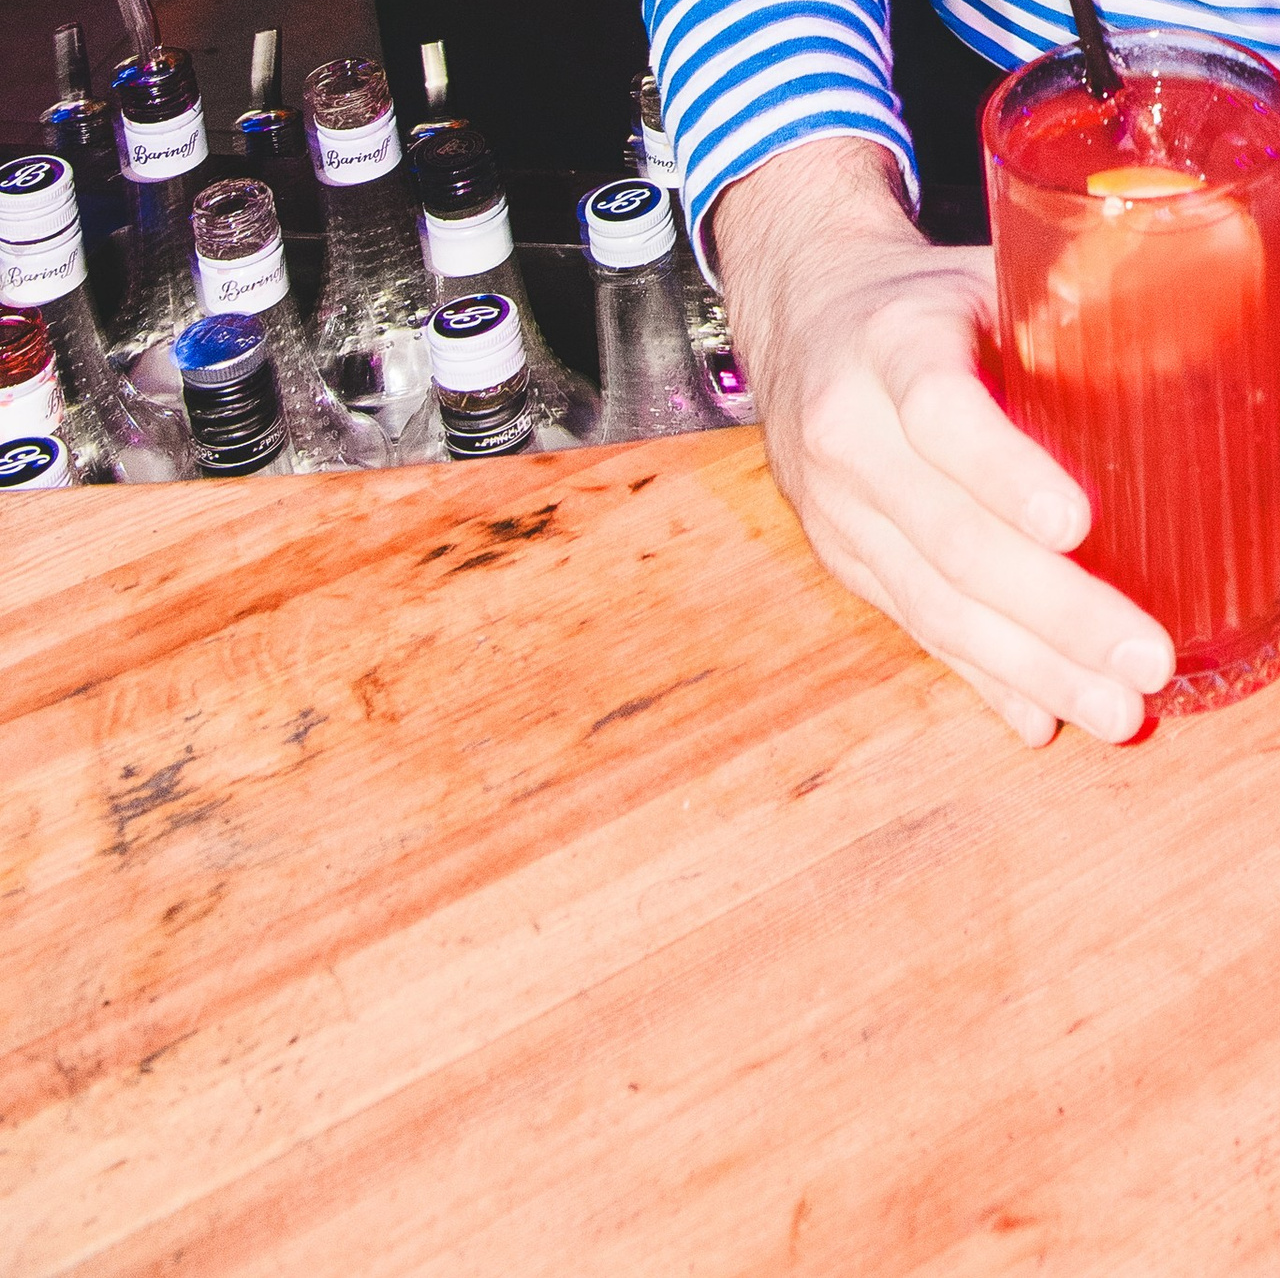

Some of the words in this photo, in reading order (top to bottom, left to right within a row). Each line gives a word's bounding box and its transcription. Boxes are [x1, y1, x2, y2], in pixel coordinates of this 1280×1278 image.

[133, 129, 199, 165] Barinoff
[325, 134, 392, 170] Barinoff
[7, 247, 79, 288] Barinoff
